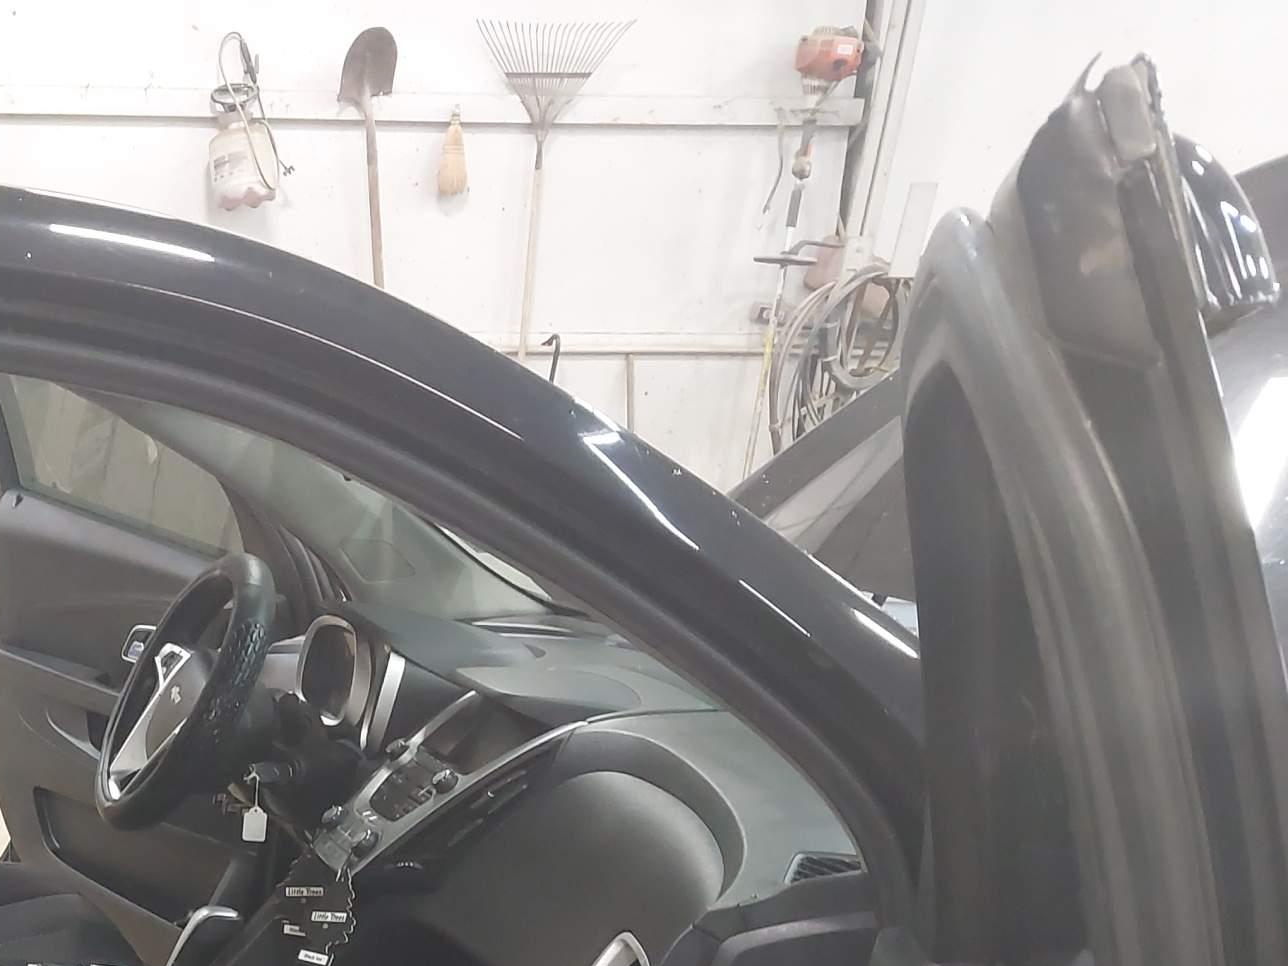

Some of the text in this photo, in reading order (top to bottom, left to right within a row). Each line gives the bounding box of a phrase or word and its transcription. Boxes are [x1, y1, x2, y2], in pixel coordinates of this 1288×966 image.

[287, 887, 304, 896] Little
[314, 912, 345, 922] Little Trees
